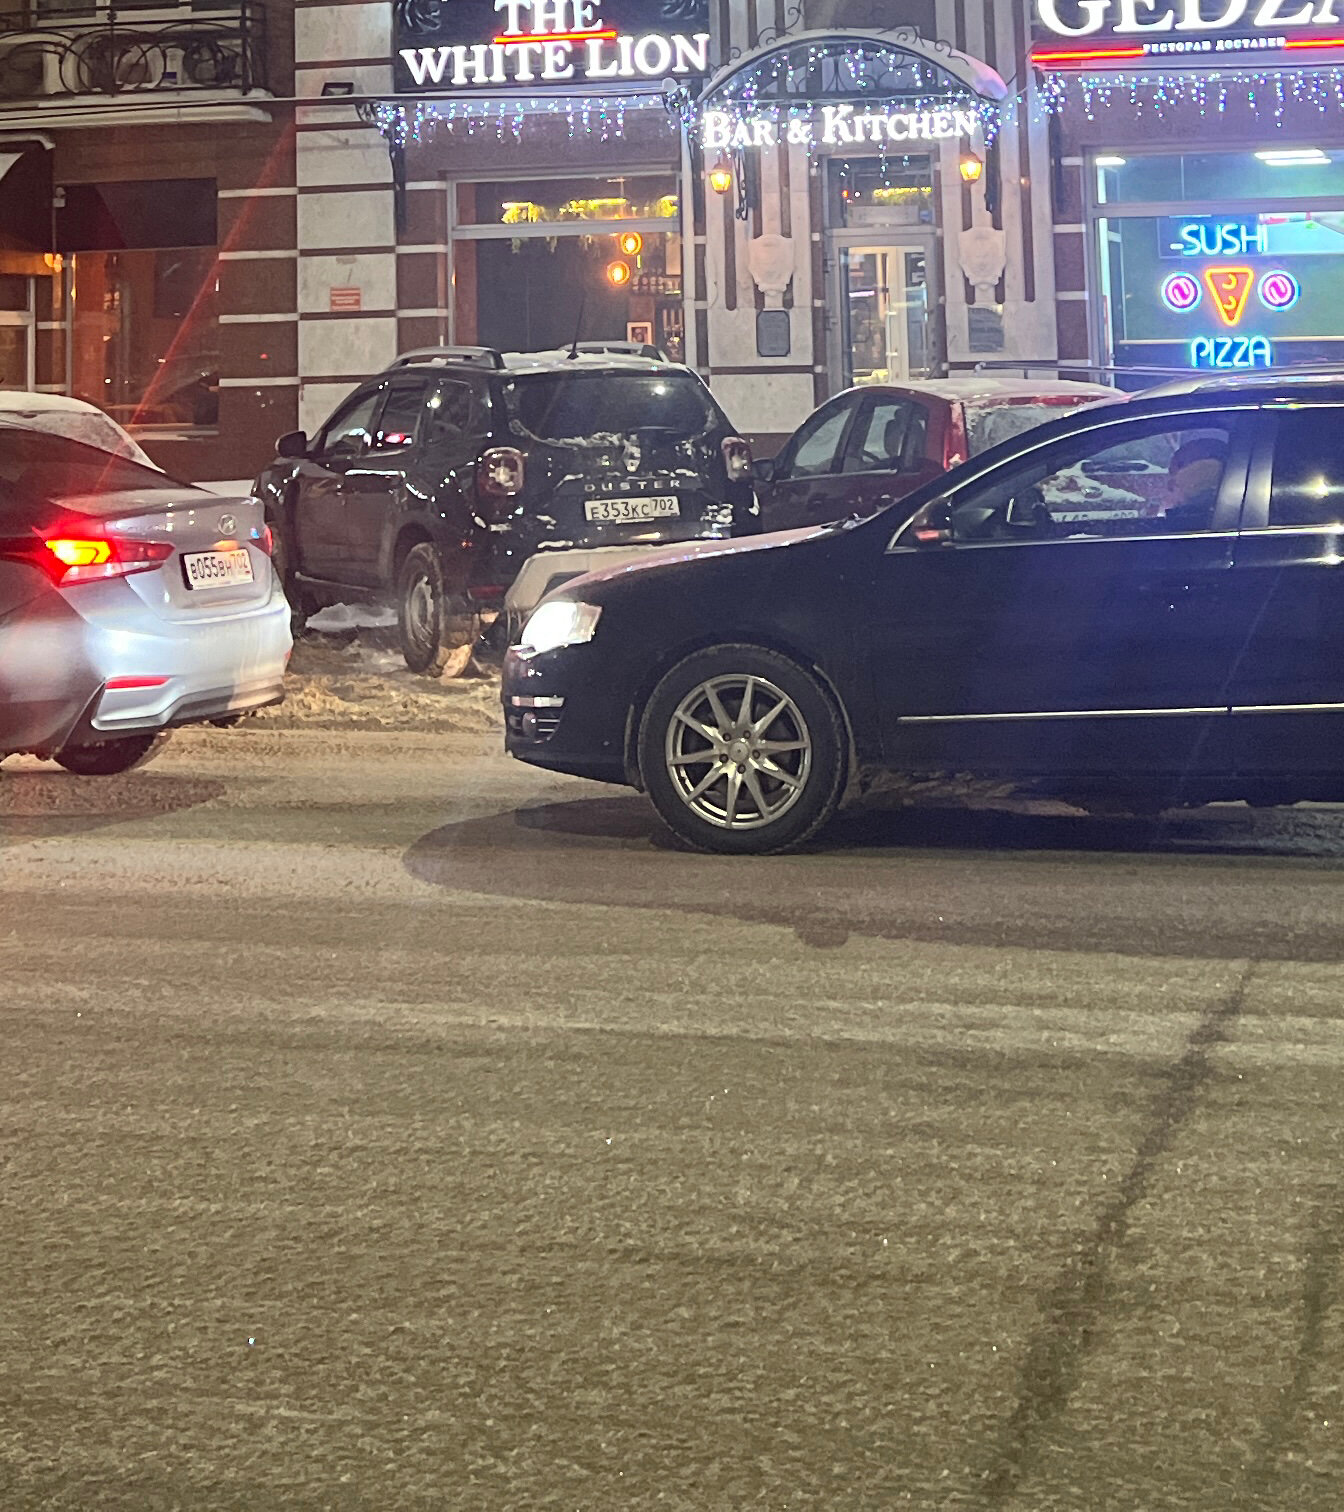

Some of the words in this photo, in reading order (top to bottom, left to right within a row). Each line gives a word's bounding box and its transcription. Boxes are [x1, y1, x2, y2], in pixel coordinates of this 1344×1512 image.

[399, 42, 574, 85] WHITE
[584, 33, 710, 78] LION
[786, 118, 811, 144] &
[1181, 223, 1269, 255] SUSHI
[1190, 336, 1272, 368] PIZZA
[584, 479, 681, 492] DUSTER
